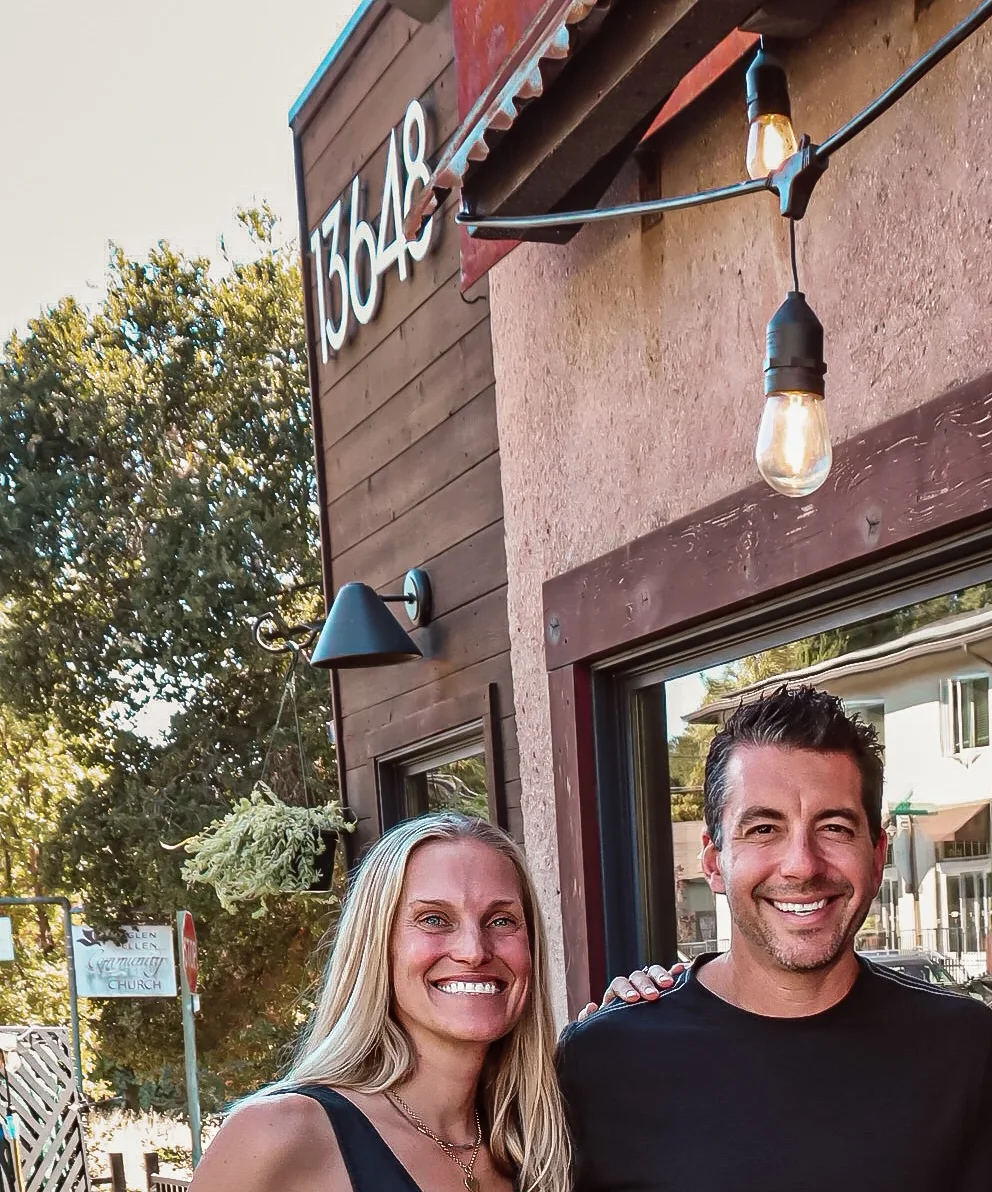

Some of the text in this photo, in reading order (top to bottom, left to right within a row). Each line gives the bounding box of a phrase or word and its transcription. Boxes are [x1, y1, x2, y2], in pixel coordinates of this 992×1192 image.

[310, 98, 434, 364] 13648
[127, 931, 157, 939] GLEN
[121, 941, 160, 950] ELLEN
[87, 949, 168, 978] Community
[108, 979, 161, 990] CHURCH
